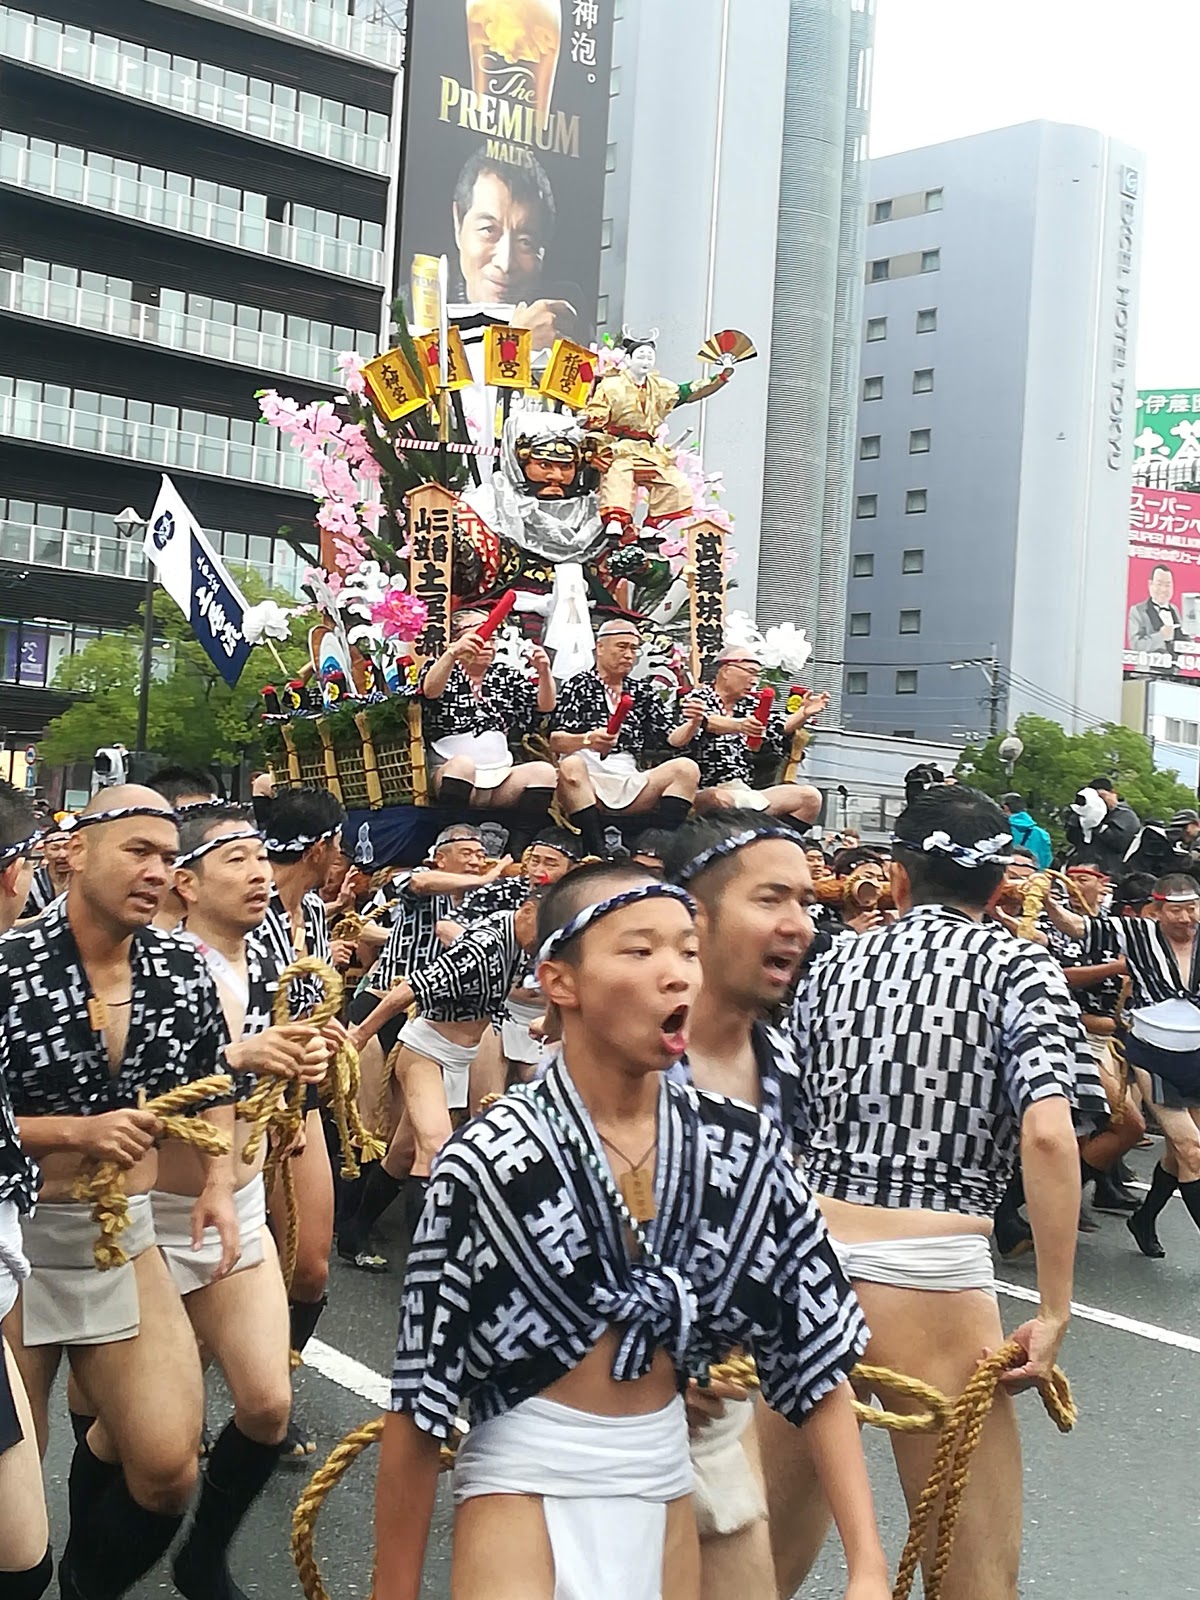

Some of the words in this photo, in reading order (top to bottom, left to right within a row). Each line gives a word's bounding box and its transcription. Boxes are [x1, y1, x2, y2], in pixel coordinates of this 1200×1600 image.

[571, 0, 598, 83] 神泡。
[438, 75, 581, 159] PREMIUM
[480, 60, 536, 104] The
[486, 138, 534, 169] MALT'S
[1117, 201, 1135, 279] EXCEL
[1111, 285, 1130, 373] HOTEL
[1107, 379, 1125, 471] TOKYU
[1129, 493, 1192, 515] スーパー
